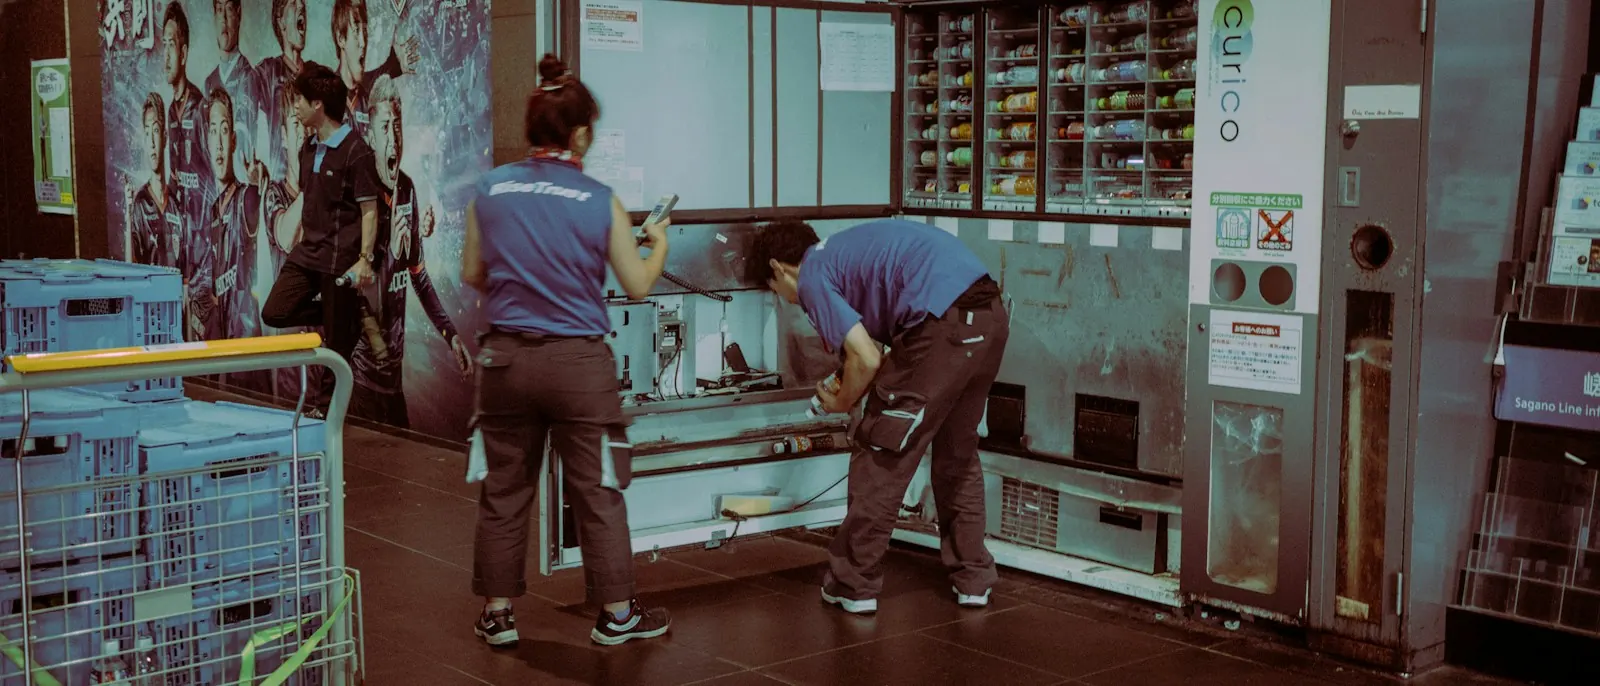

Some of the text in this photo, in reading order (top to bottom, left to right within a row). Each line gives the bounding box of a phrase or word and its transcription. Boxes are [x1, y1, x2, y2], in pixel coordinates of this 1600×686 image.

[1220, 5, 1246, 142] curico
[1515, 396, 1556, 413] Sagano
[1558, 401, 1582, 416] Line
